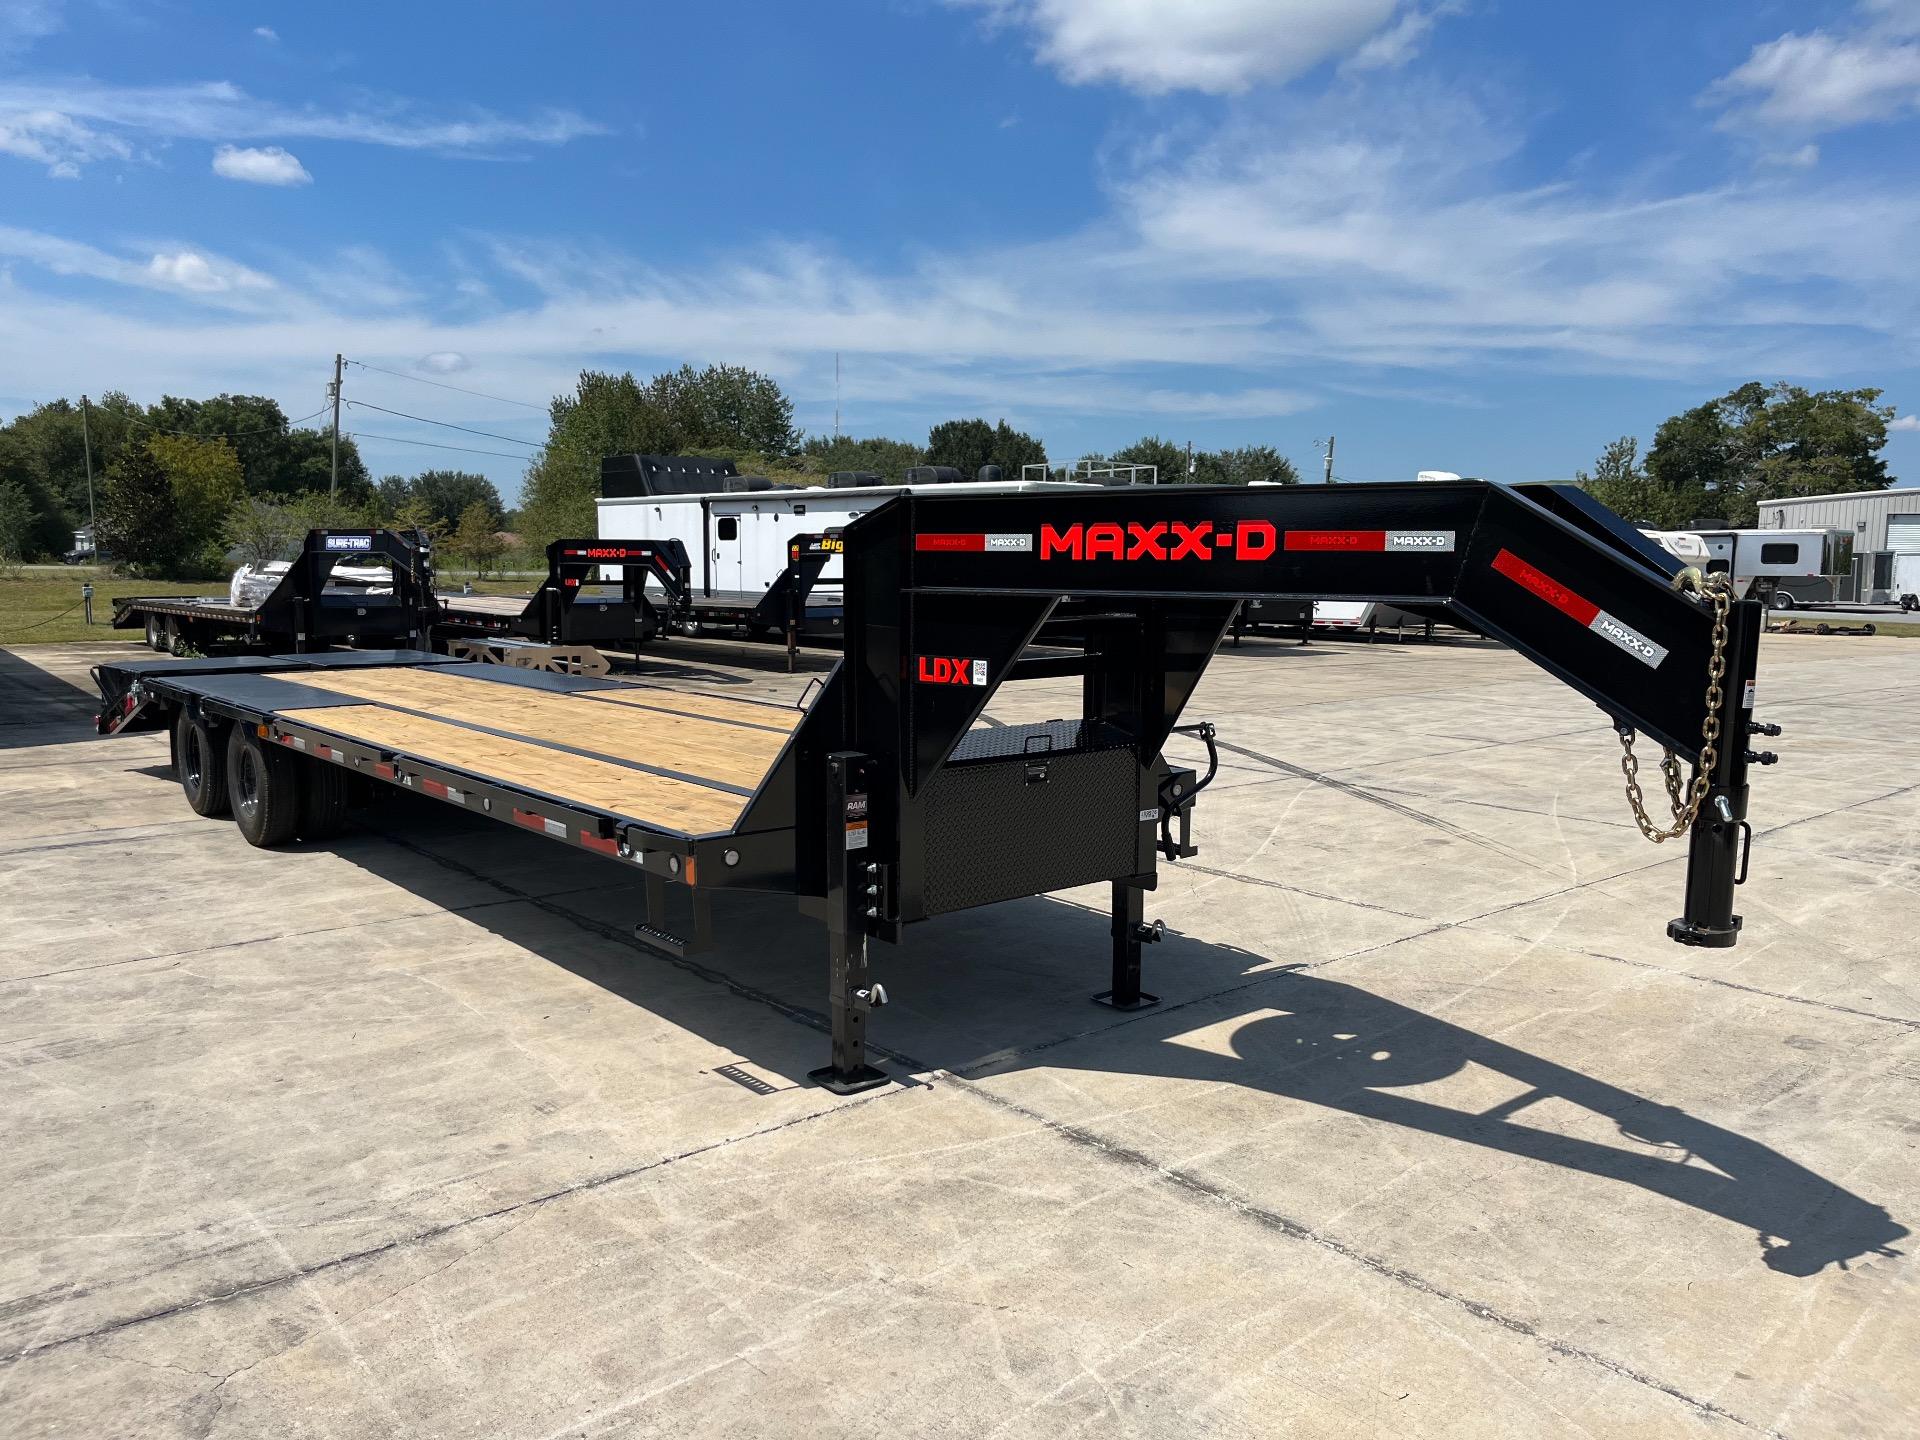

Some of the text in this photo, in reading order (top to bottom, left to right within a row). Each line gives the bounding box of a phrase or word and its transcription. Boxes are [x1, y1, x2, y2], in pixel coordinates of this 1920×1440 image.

[327, 538, 370, 548] SURE-TRAC
[990, 538, 1026, 547] MAXX-D
[1040, 520, 1276, 560] MAXX-D
[1310, 536, 1358, 545] MAXX-D
[1393, 536, 1445, 546] MAXX-D
[821, 538, 843, 553] Big
[587, 548, 627, 558] MAXX-D
[1600, 620, 1655, 657] MAXX-D
[919, 656, 970, 685] LDX
[847, 800, 866, 810] RAM
